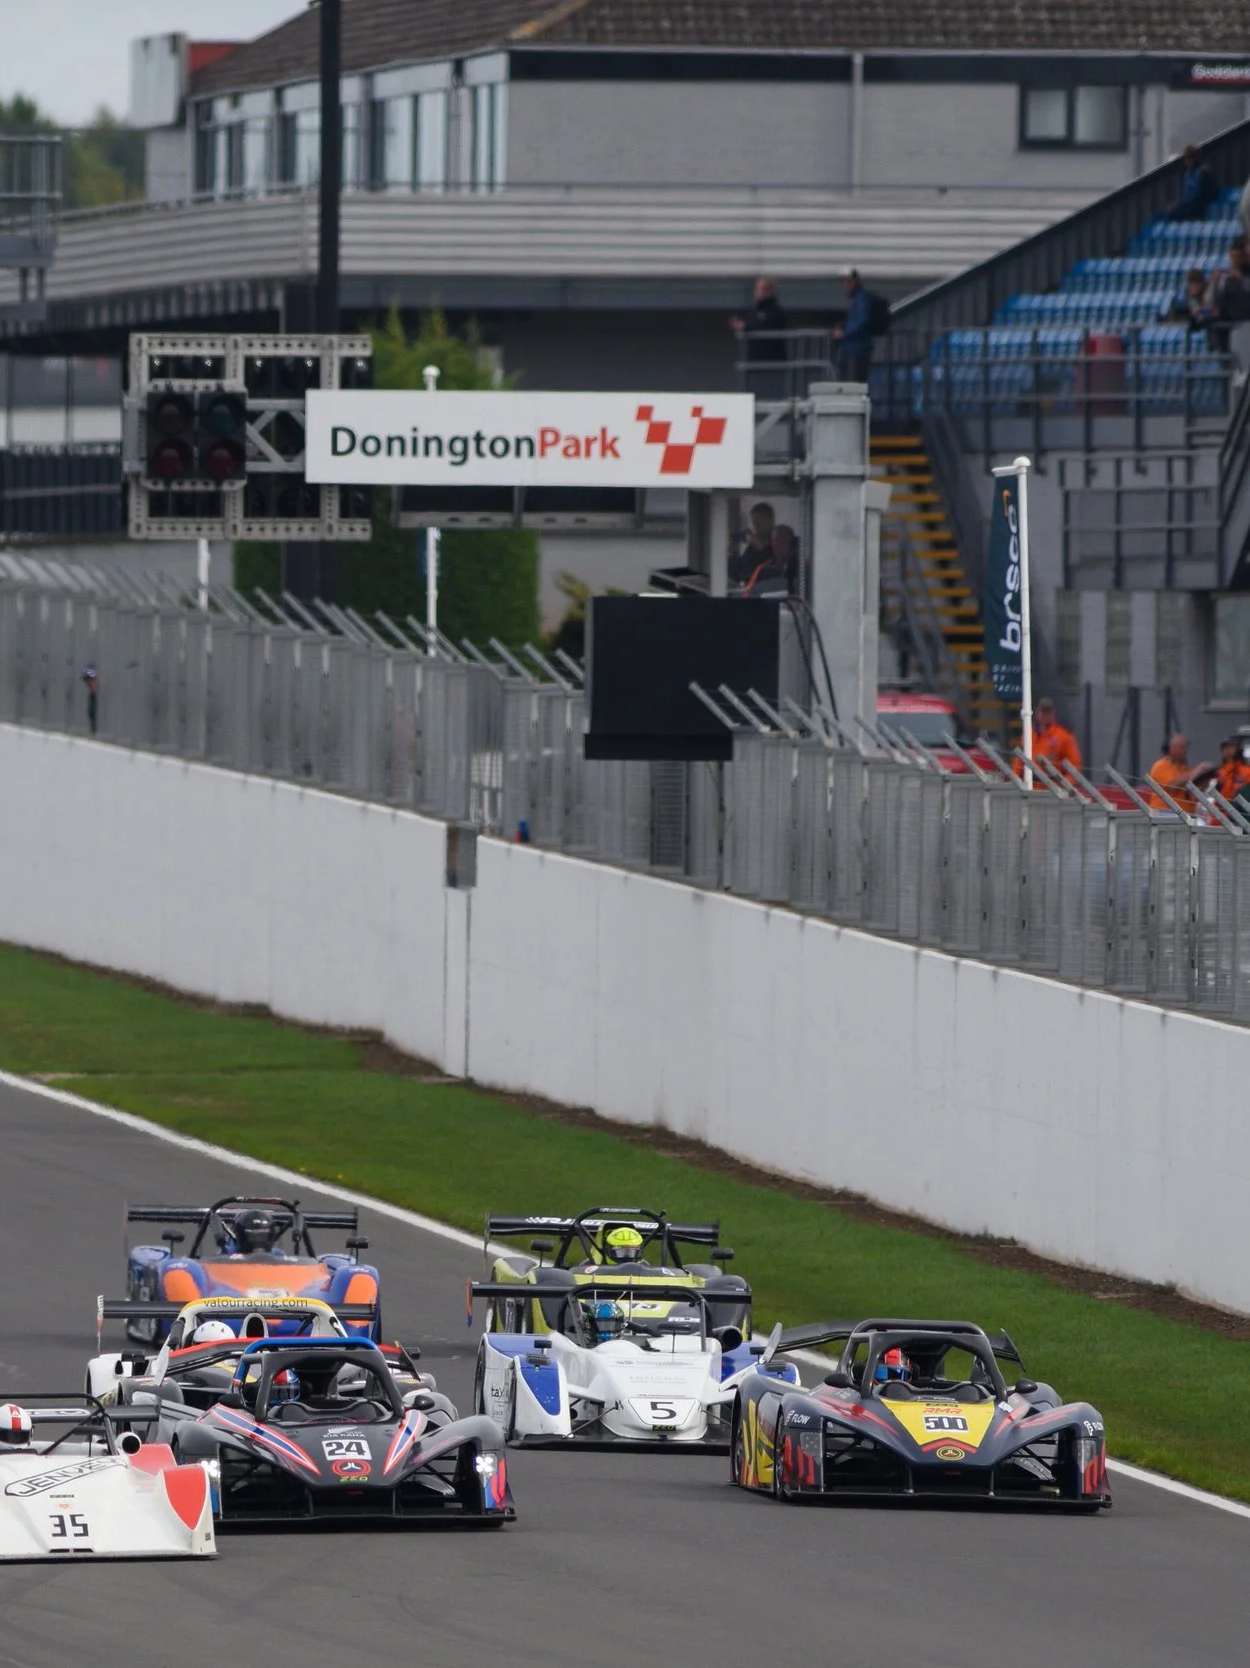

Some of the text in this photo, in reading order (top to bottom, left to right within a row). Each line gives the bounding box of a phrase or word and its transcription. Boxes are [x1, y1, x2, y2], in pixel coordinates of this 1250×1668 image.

[331, 427, 620, 466] DoningtonPark
[650, 1401, 677, 1420] 5
[325, 1441, 366, 1457] 24
[49, 1514, 90, 1538] 35
